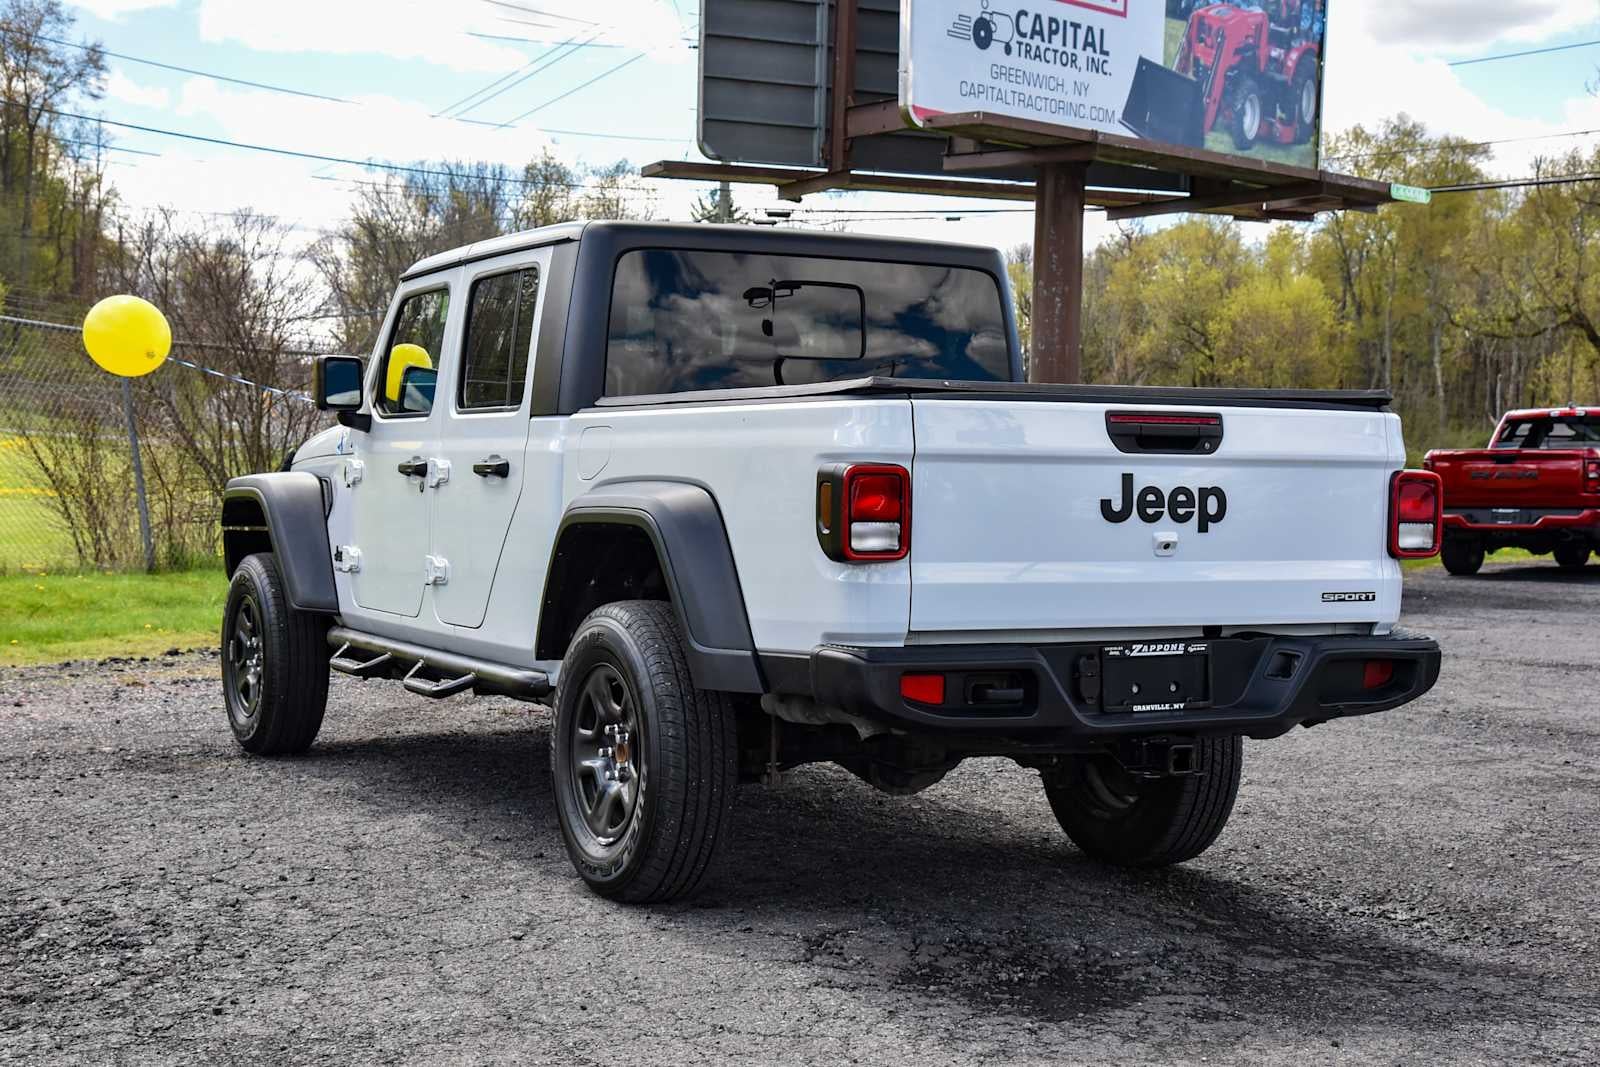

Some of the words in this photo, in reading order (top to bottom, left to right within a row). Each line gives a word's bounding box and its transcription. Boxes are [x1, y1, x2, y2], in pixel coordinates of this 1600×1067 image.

[1015, 9, 1110, 57] CAPITAL
[1016, 41, 1082, 73] TRACTOR,
[1086, 56, 1112, 76] INC.
[990, 64, 1068, 96] GREENWICH,
[1073, 80, 1090, 97] NY
[959, 81, 1116, 125] CAPITALTRACTORINC.COM
[1100, 473, 1227, 533] Jeep
[1322, 592, 1376, 602] SPORT
[1130, 643, 1185, 656] ZAPPONE
